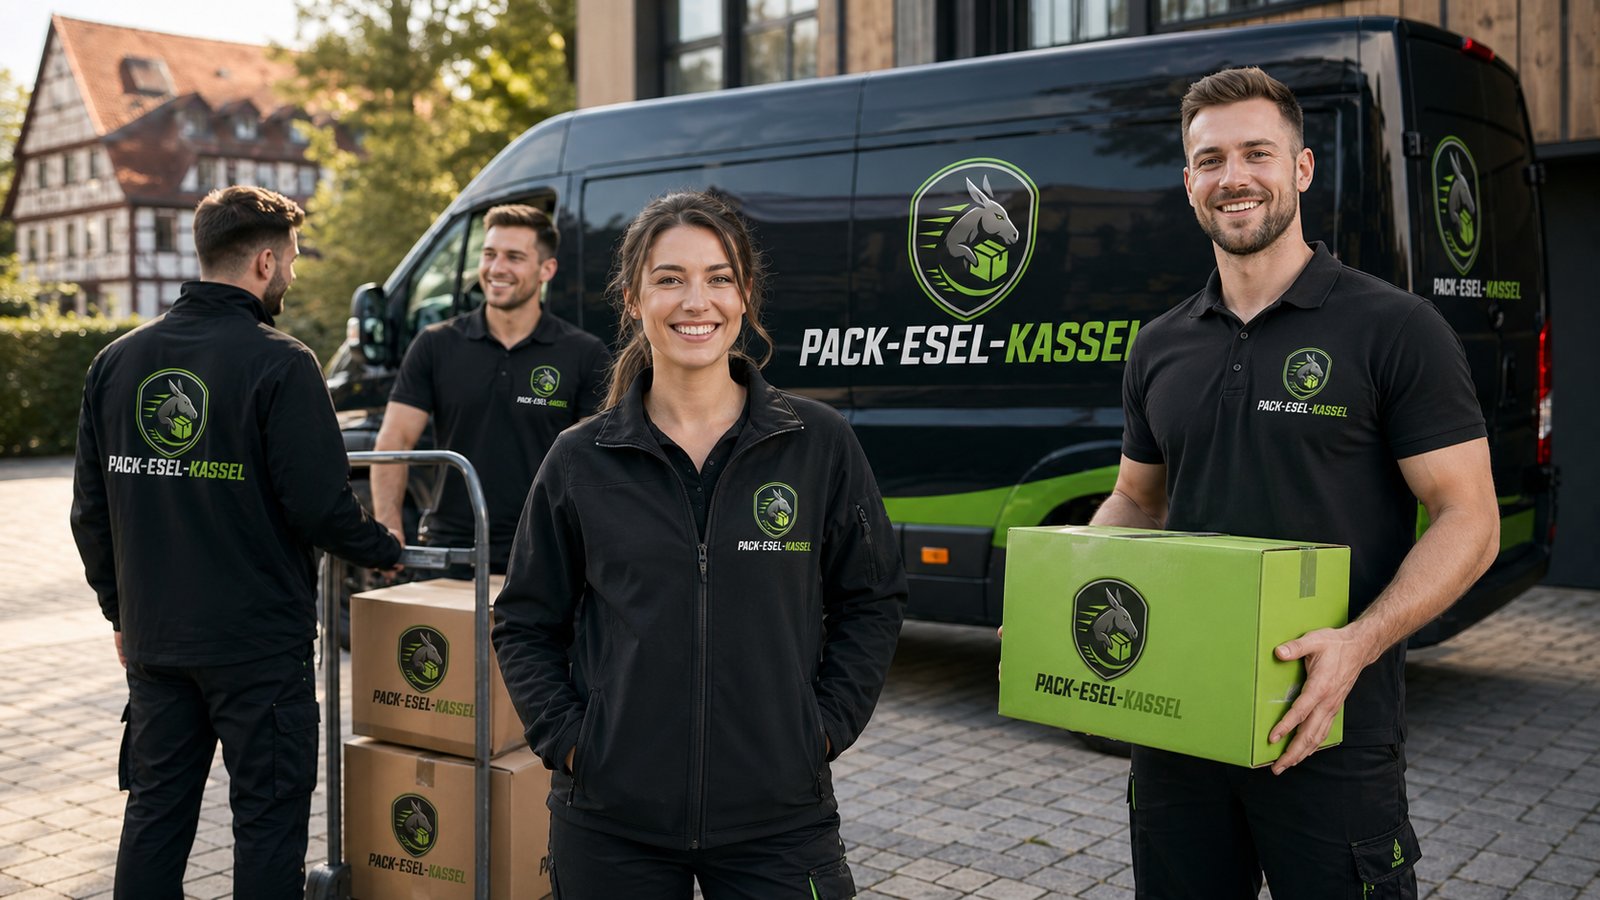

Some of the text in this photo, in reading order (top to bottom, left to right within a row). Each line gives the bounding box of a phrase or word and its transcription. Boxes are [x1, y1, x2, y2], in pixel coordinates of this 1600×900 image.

[1433, 278, 1522, 300] PACK-ESEL-KASSEL
[1257, 400, 1348, 417] PACK-ESEL-KASSEL
[108, 455, 245, 481] PACK-ESEL-KASSEL
[737, 541, 812, 552] PACK-ESEL-KASSEL
[372, 689, 476, 719] PACK-ESEL-KASSEL
[1035, 673, 1182, 720] PACK-ESEL-KASSEL
[368, 853, 466, 884] PACK-ESEL-KASSEL
